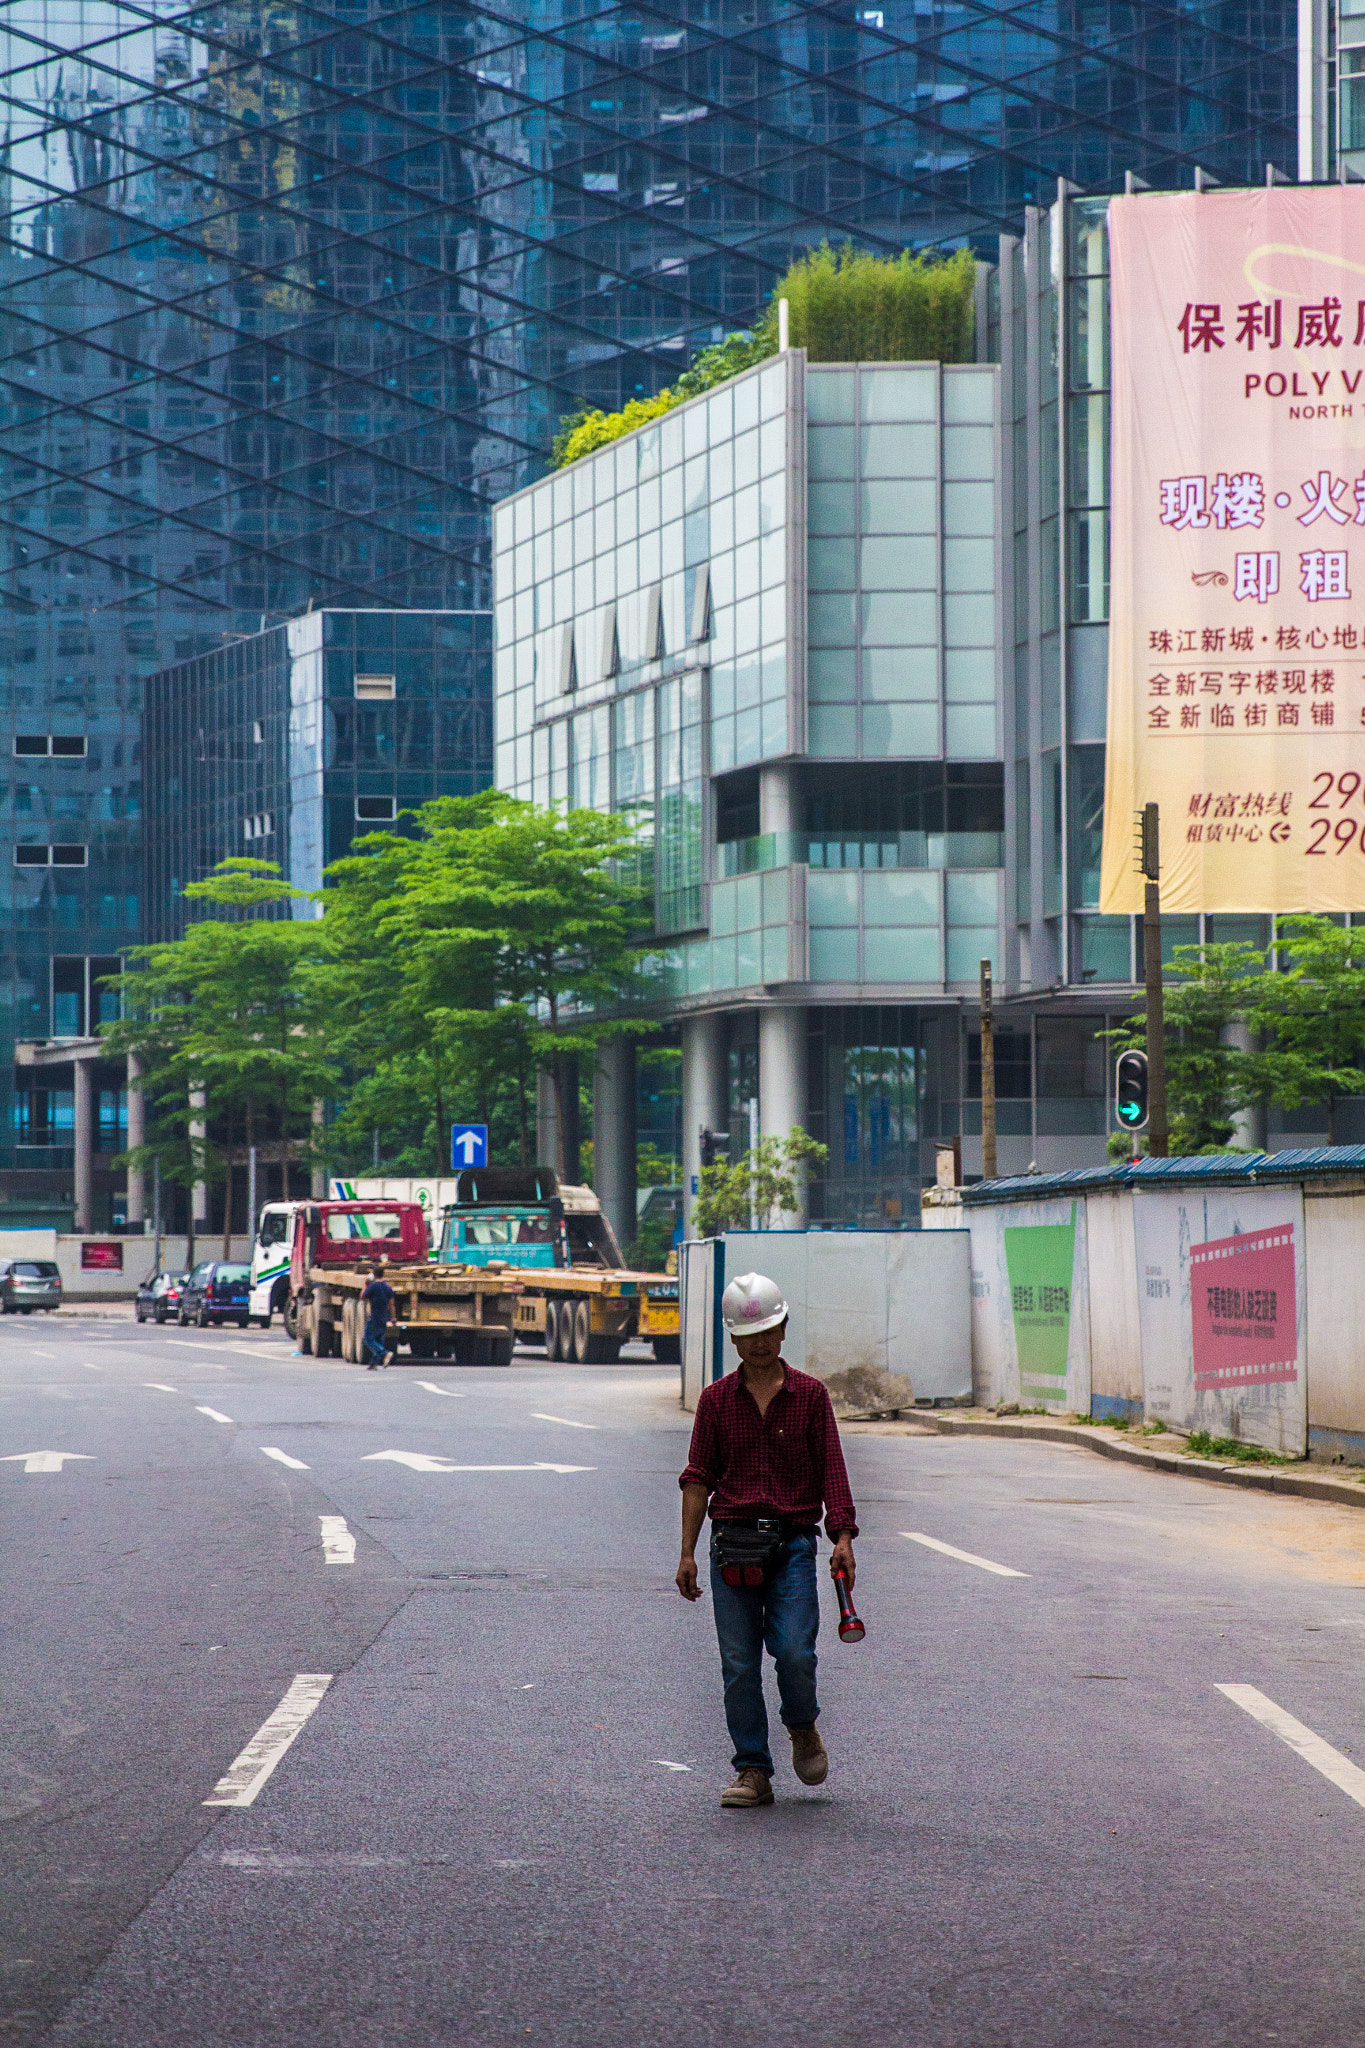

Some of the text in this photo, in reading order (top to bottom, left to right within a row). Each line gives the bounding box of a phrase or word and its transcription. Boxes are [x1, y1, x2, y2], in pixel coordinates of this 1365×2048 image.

[1177, 296, 1365, 354] 保利威
[1245, 370, 1331, 399] POLY
[1289, 404, 1353, 420] NORTH
[1159, 470, 1365, 531] 现楼·火
[1148, 624, 1365, 654] 珠江新城·核心地
[1148, 669, 1335, 697] 全新写字楼现楼
[1148, 701, 1335, 729] 全新临街商铺
[1308, 770, 1365, 809] 29
[1187, 791, 1293, 818] 财富热线
[1187, 822, 1263, 843] 租赁中心
